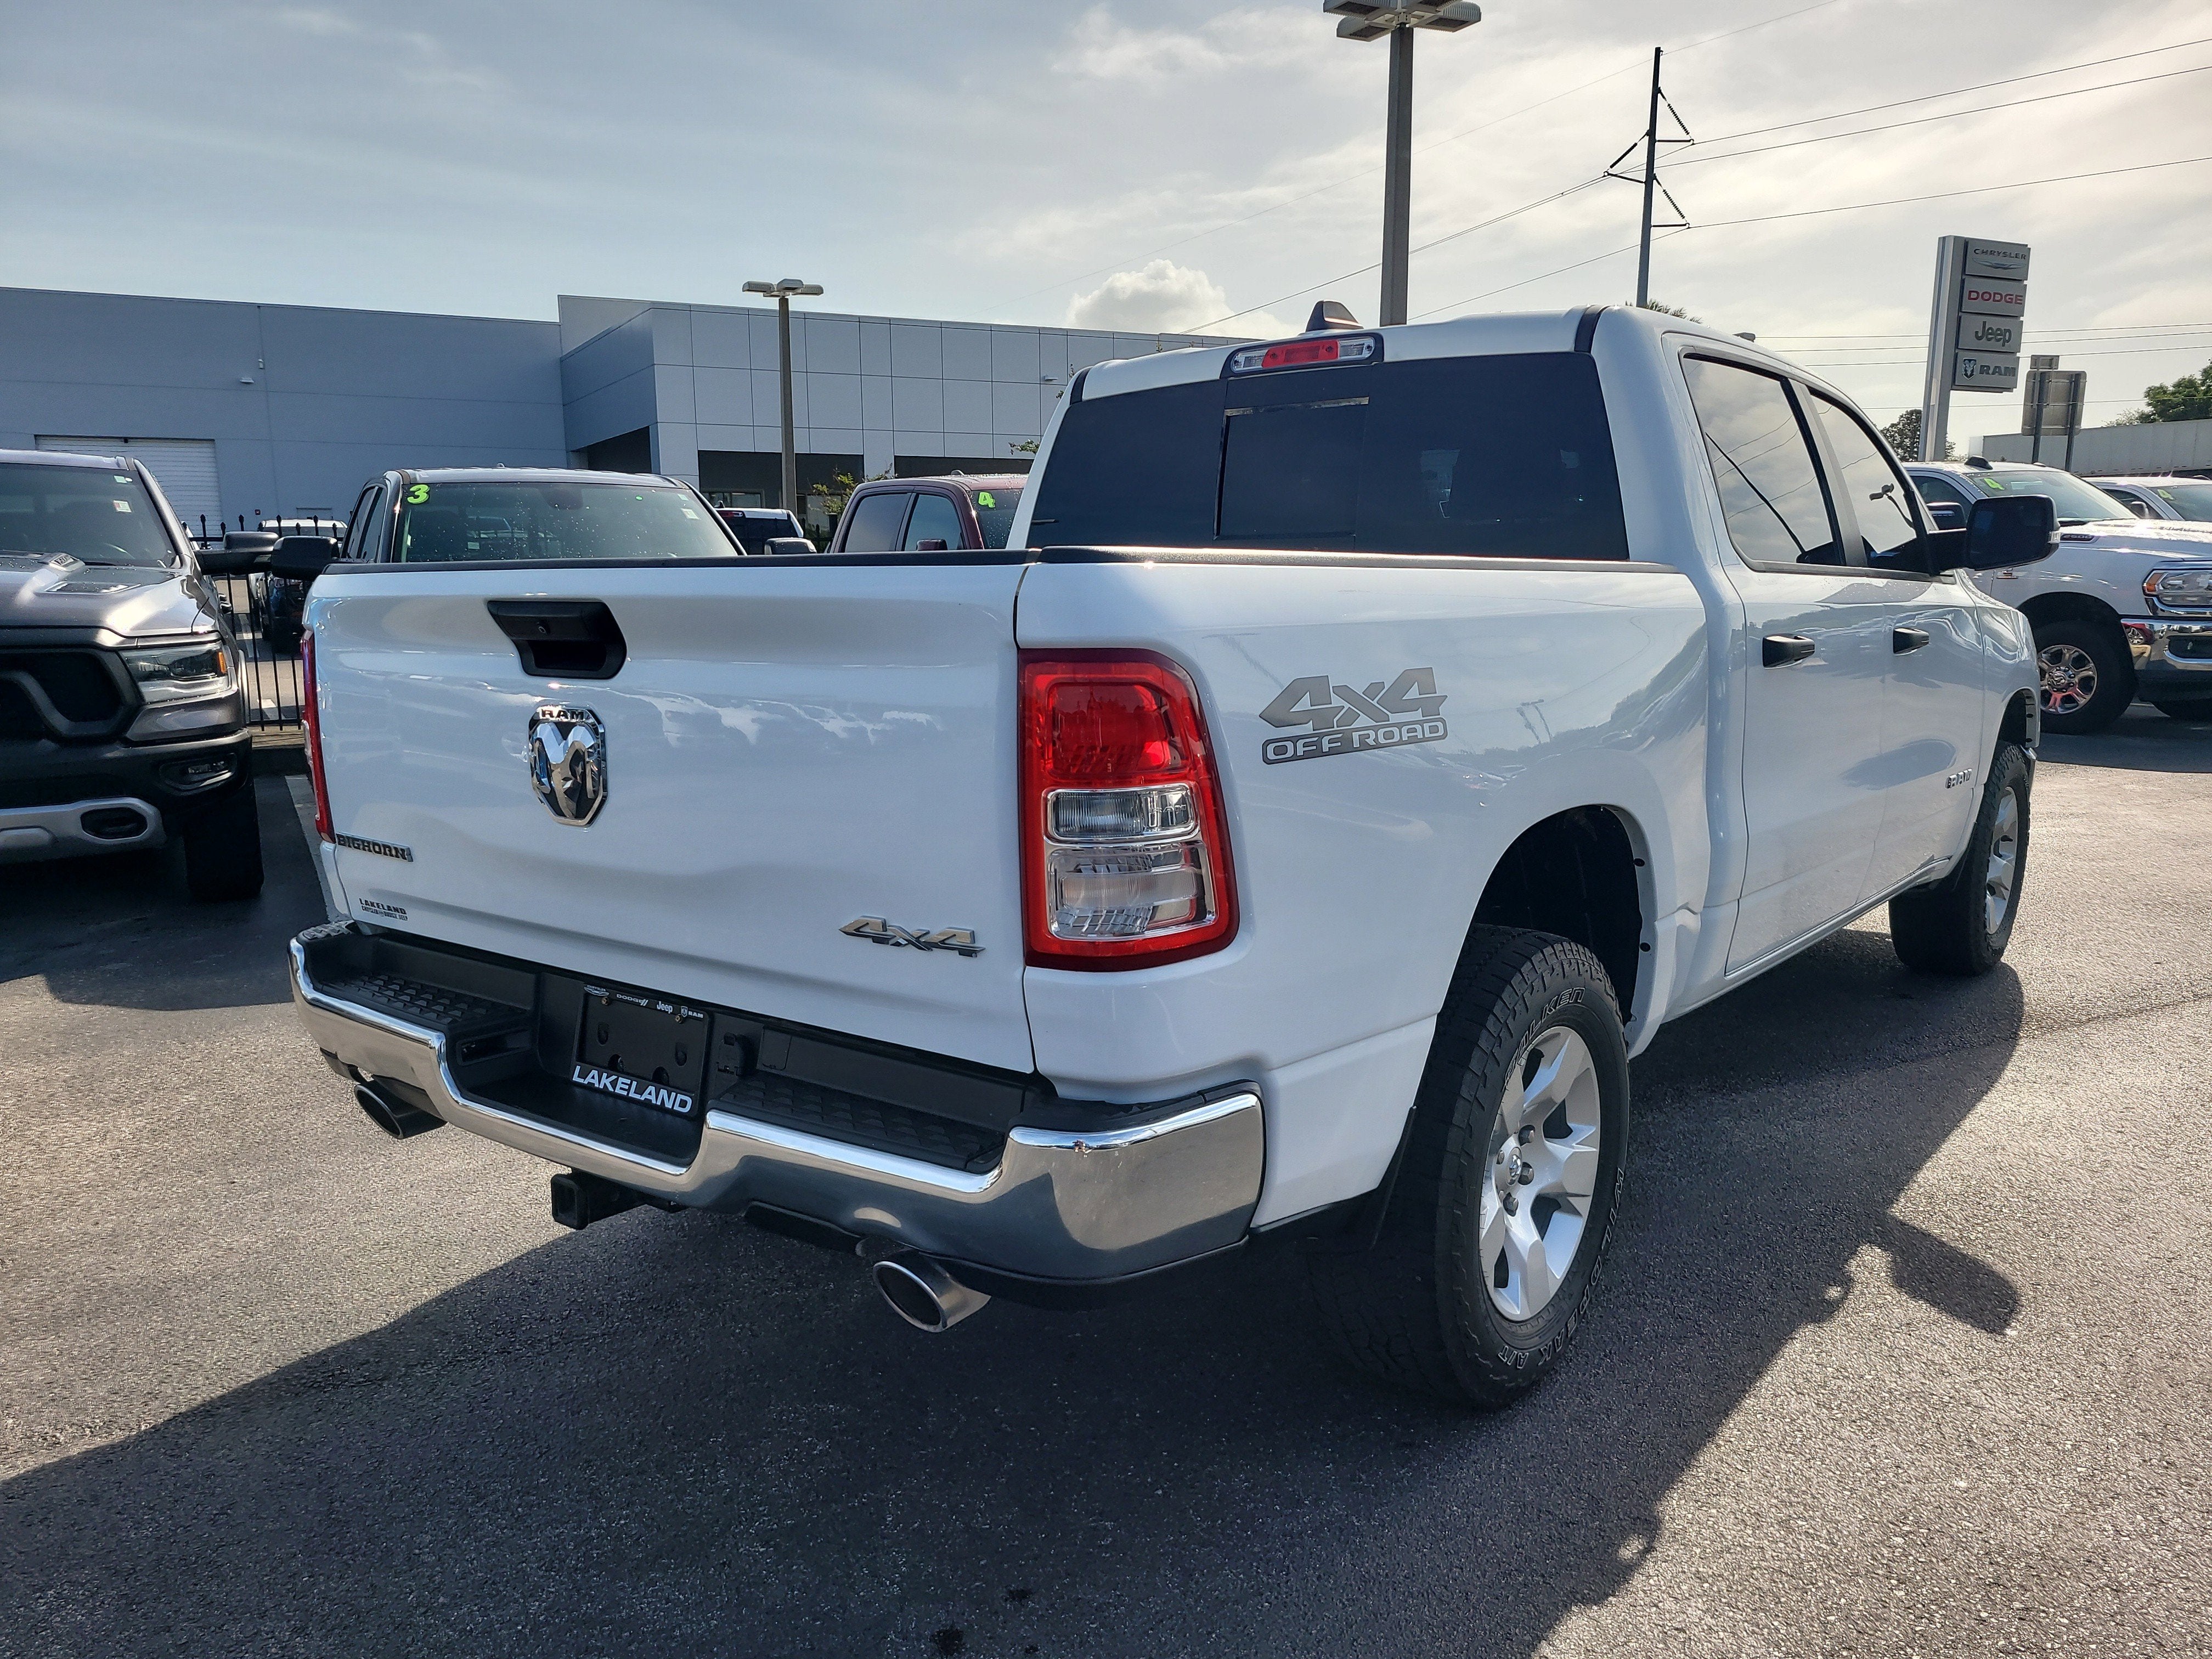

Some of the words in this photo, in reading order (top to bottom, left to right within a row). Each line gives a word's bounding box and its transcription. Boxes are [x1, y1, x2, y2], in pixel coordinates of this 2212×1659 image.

[1974, 249, 2027, 260] CHRYSLER
[1968, 290, 2023, 305] DODGE
[1975, 321, 2012, 347] Jeep
[1979, 364, 2016, 377] RAM
[1984, 478, 2005, 490] 4
[407, 484, 430, 504] 3
[978, 492, 995, 508] 4
[541, 709, 584, 721] RAM
[1266, 733, 1344, 760] OFF
[1352, 721, 1445, 748] ROAD
[1945, 769, 1972, 788] RAM
[359, 898, 407, 915] LAKELAND
[657, 1001, 673, 1014] Jeep
[688, 1011, 704, 1019] RAM
[572, 1065, 693, 1113] LAKELAND
